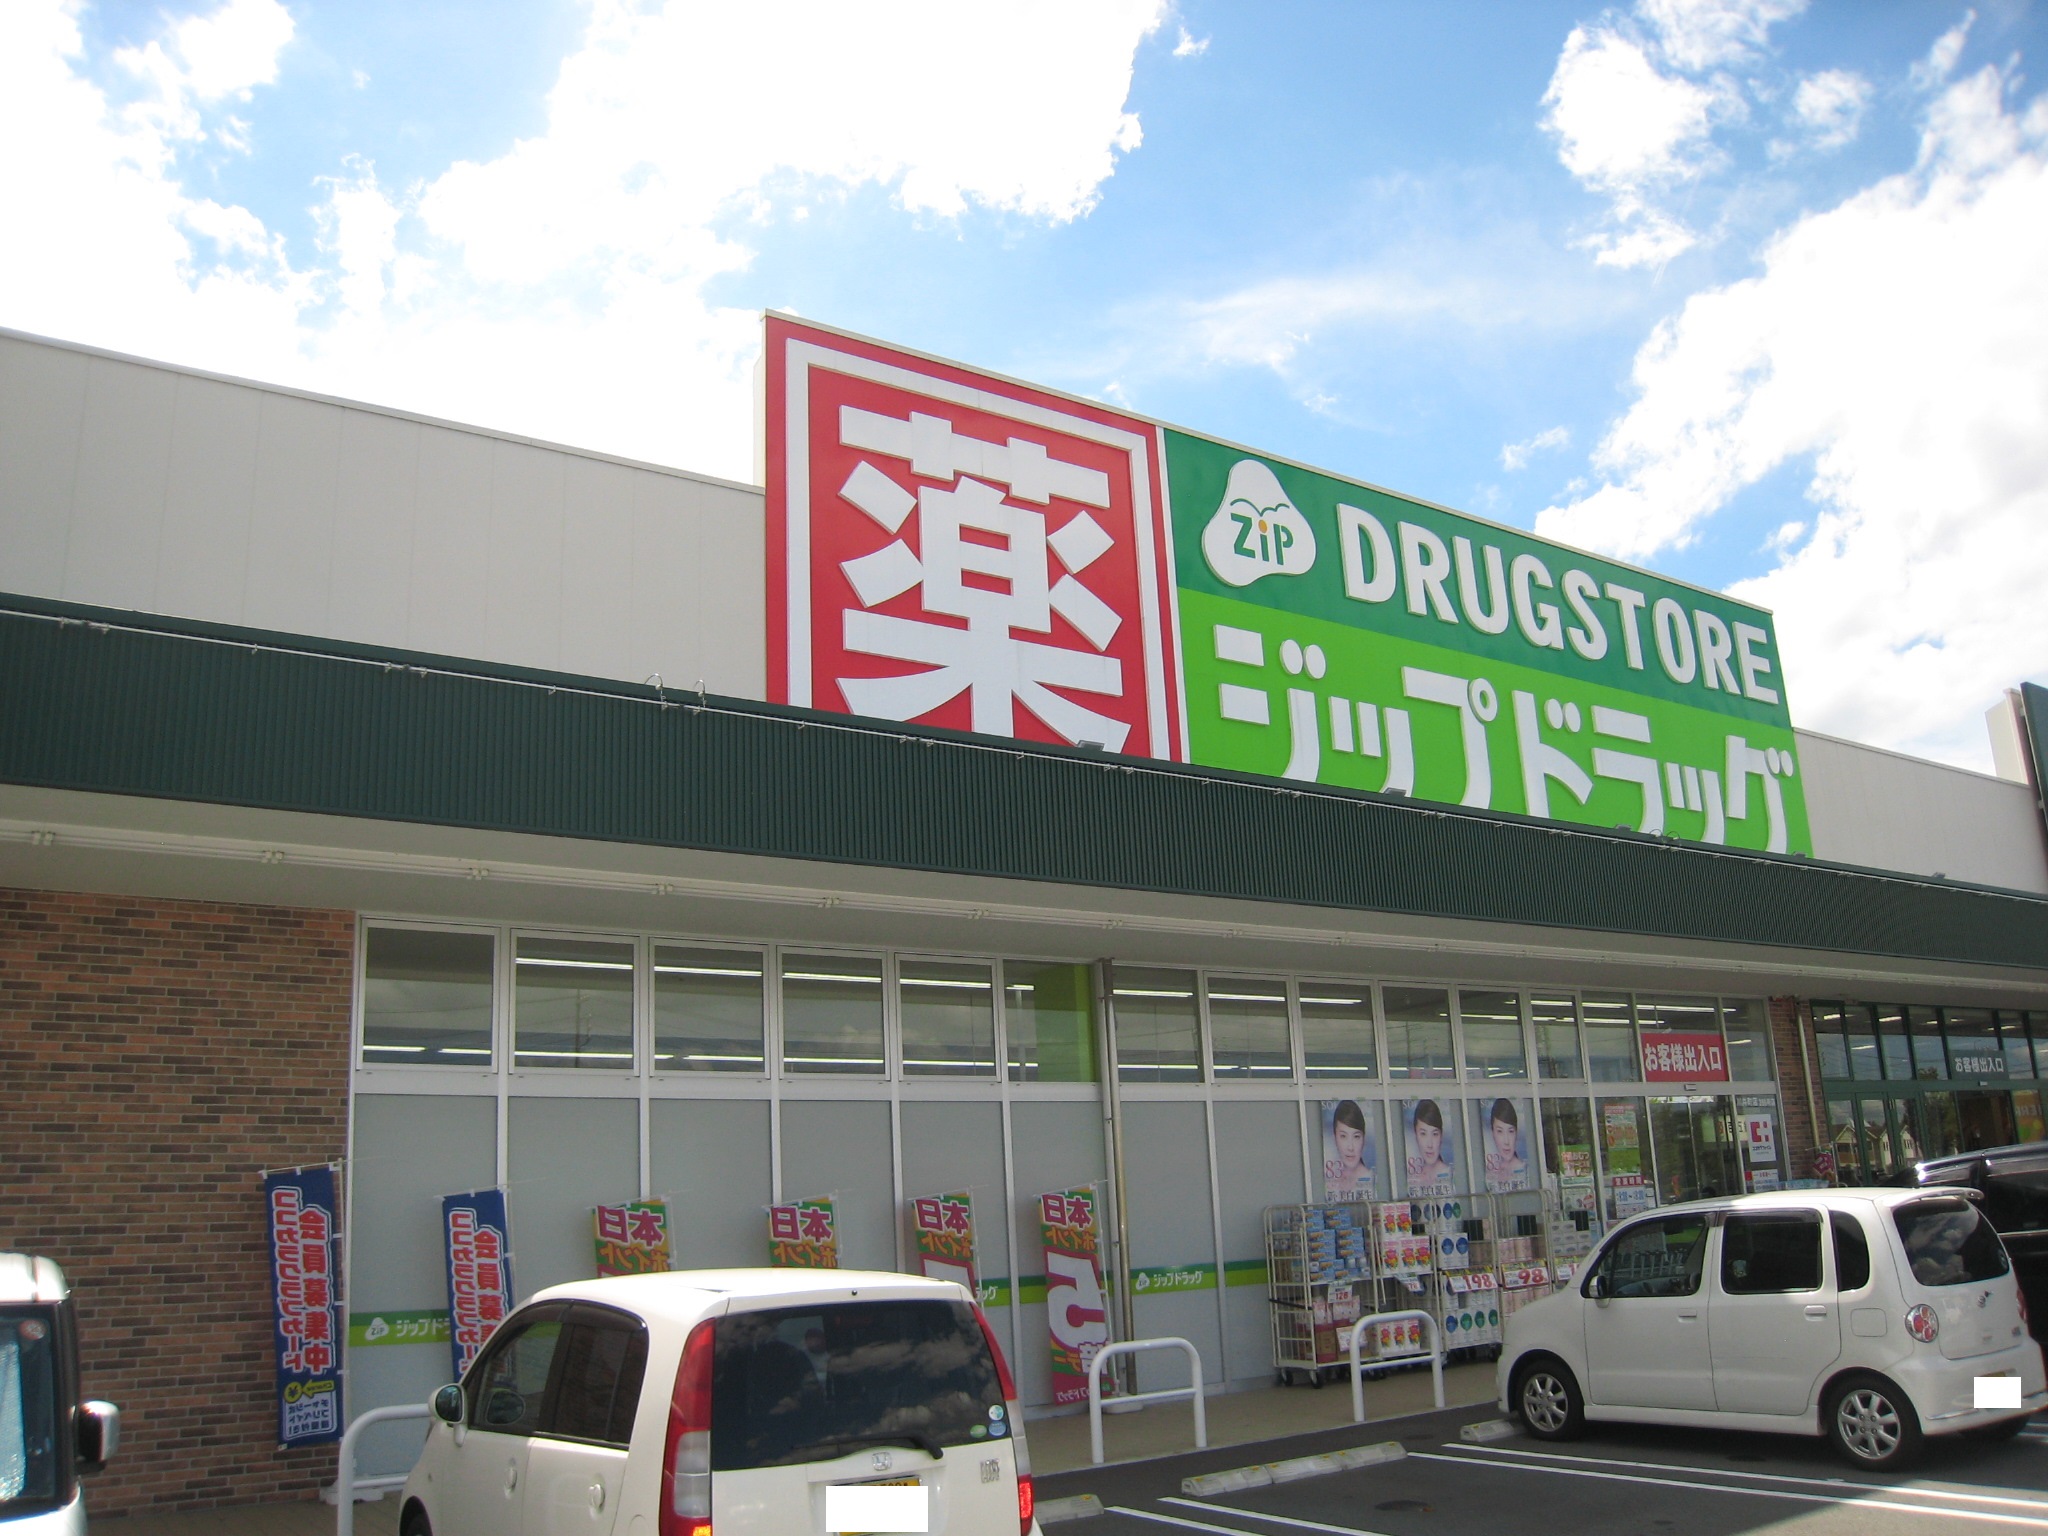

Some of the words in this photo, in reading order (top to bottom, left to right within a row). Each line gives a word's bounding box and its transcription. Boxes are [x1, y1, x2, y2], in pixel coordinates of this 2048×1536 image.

[835, 404, 1132, 752] 薬
[1337, 503, 1779, 705] DRUGSTORE
[1213, 624, 1794, 854] ジップドラッグ
[1645, 1043, 1722, 1072] お客様出入口
[1955, 1057, 2004, 1073] お客様出入口
[1153, 1270, 1204, 1287] ジップドラッグ
[1462, 1273, 1493, 1290] 198
[1517, 1268, 1544, 1285] 98
